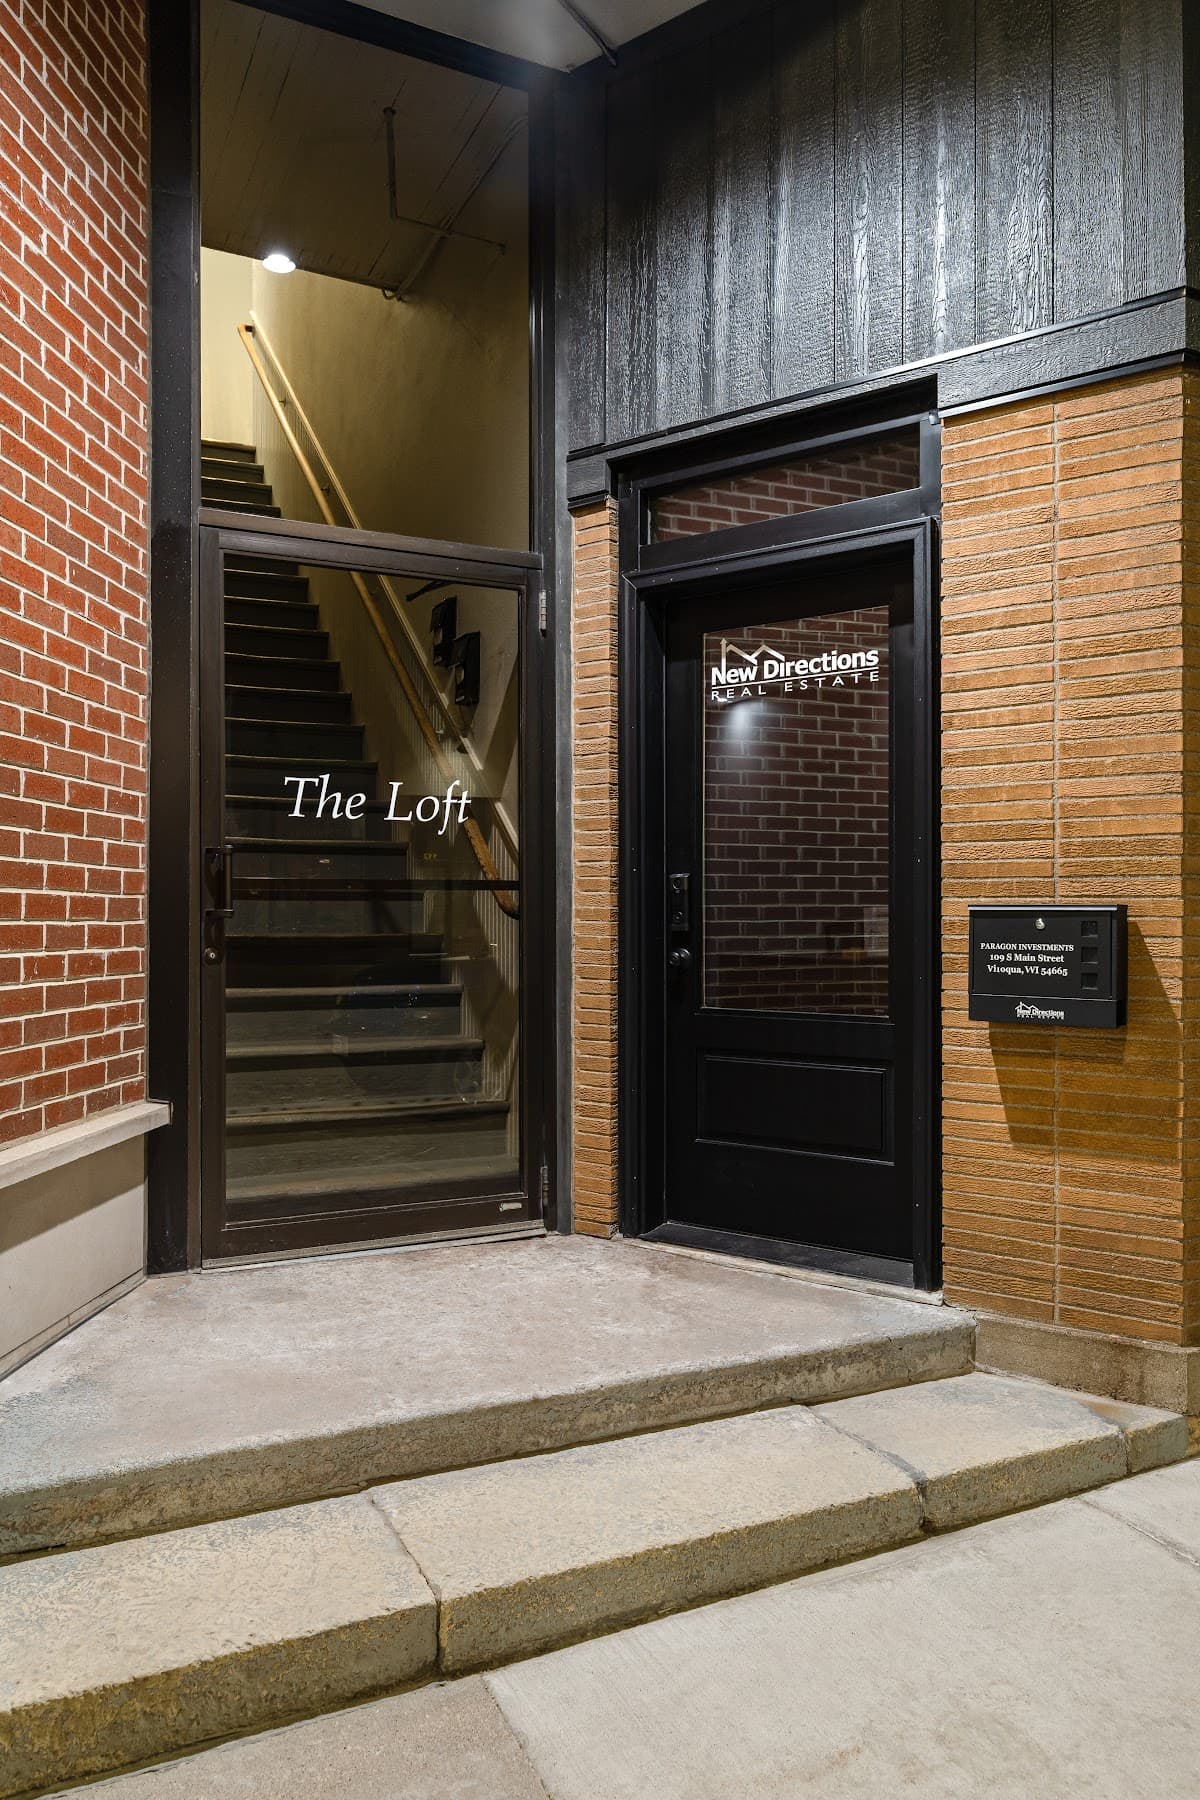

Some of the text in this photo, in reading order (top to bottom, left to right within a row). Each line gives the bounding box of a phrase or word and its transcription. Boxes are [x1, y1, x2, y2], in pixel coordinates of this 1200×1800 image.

[711, 650, 880, 686] New Directions
[711, 670, 880, 701] REAL ESTATE
[283, 773, 472, 836] The Loft
[980, 942, 1075, 952] PARAGON INVESTMENTS
[990, 952, 1065, 963] 109 S Main Street
[1025, 965, 1040, 975] WI
[1040, 966, 1068, 977] 54665
